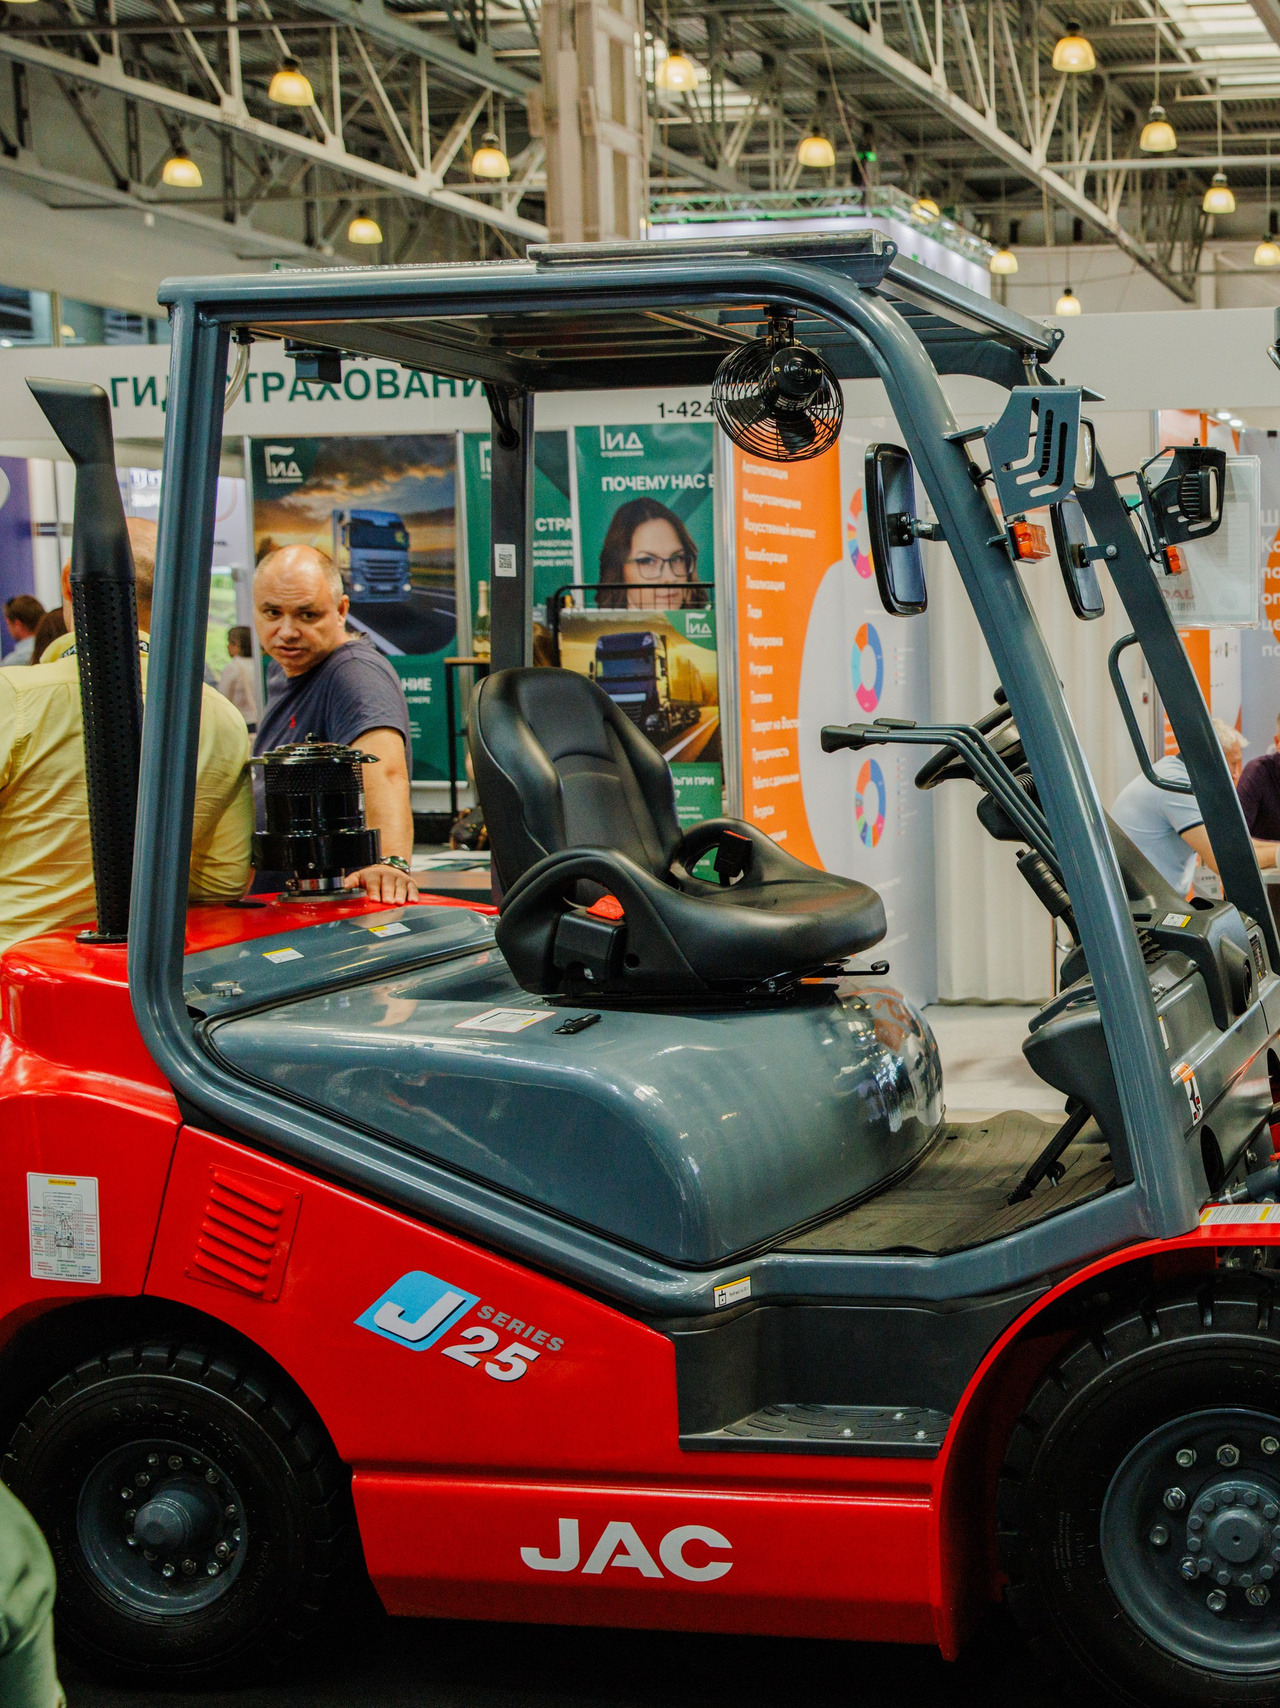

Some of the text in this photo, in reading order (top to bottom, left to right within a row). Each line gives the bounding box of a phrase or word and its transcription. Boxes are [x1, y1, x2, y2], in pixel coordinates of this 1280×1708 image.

[110, 376, 168, 412] ГИ
[601, 475, 669, 492] ПОЧЕМУ
[671, 473, 706, 490] НАС
[373, 1291, 565, 1352] J SERIES
[441, 1326, 541, 1382] 25
[520, 1517, 734, 1582] JAC
